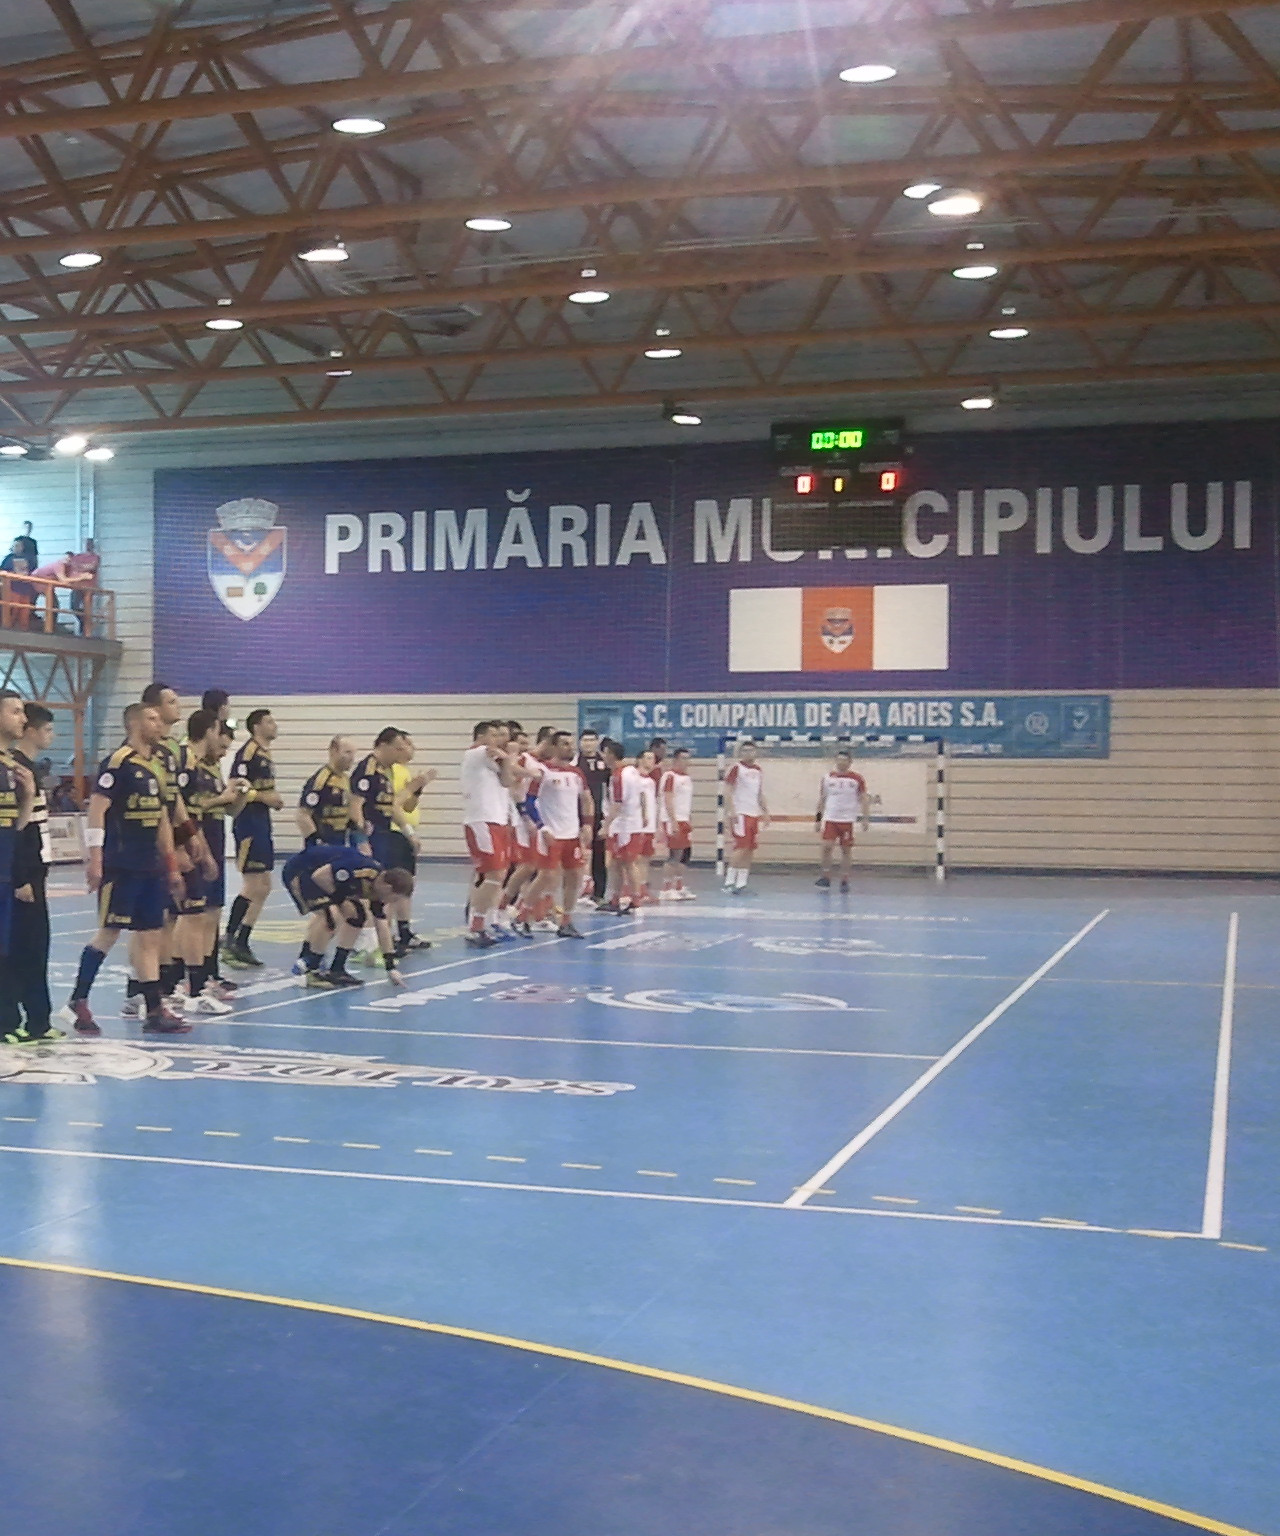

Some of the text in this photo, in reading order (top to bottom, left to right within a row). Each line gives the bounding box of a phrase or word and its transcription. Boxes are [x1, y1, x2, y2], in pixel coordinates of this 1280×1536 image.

[811, 431, 863, 449] 00:00
[324, 481, 1253, 574] PRIMĂRIA MUCIPIULUI
[633, 701, 1003, 728] S.C. COMPANIA DE APA ARIES S.A.
